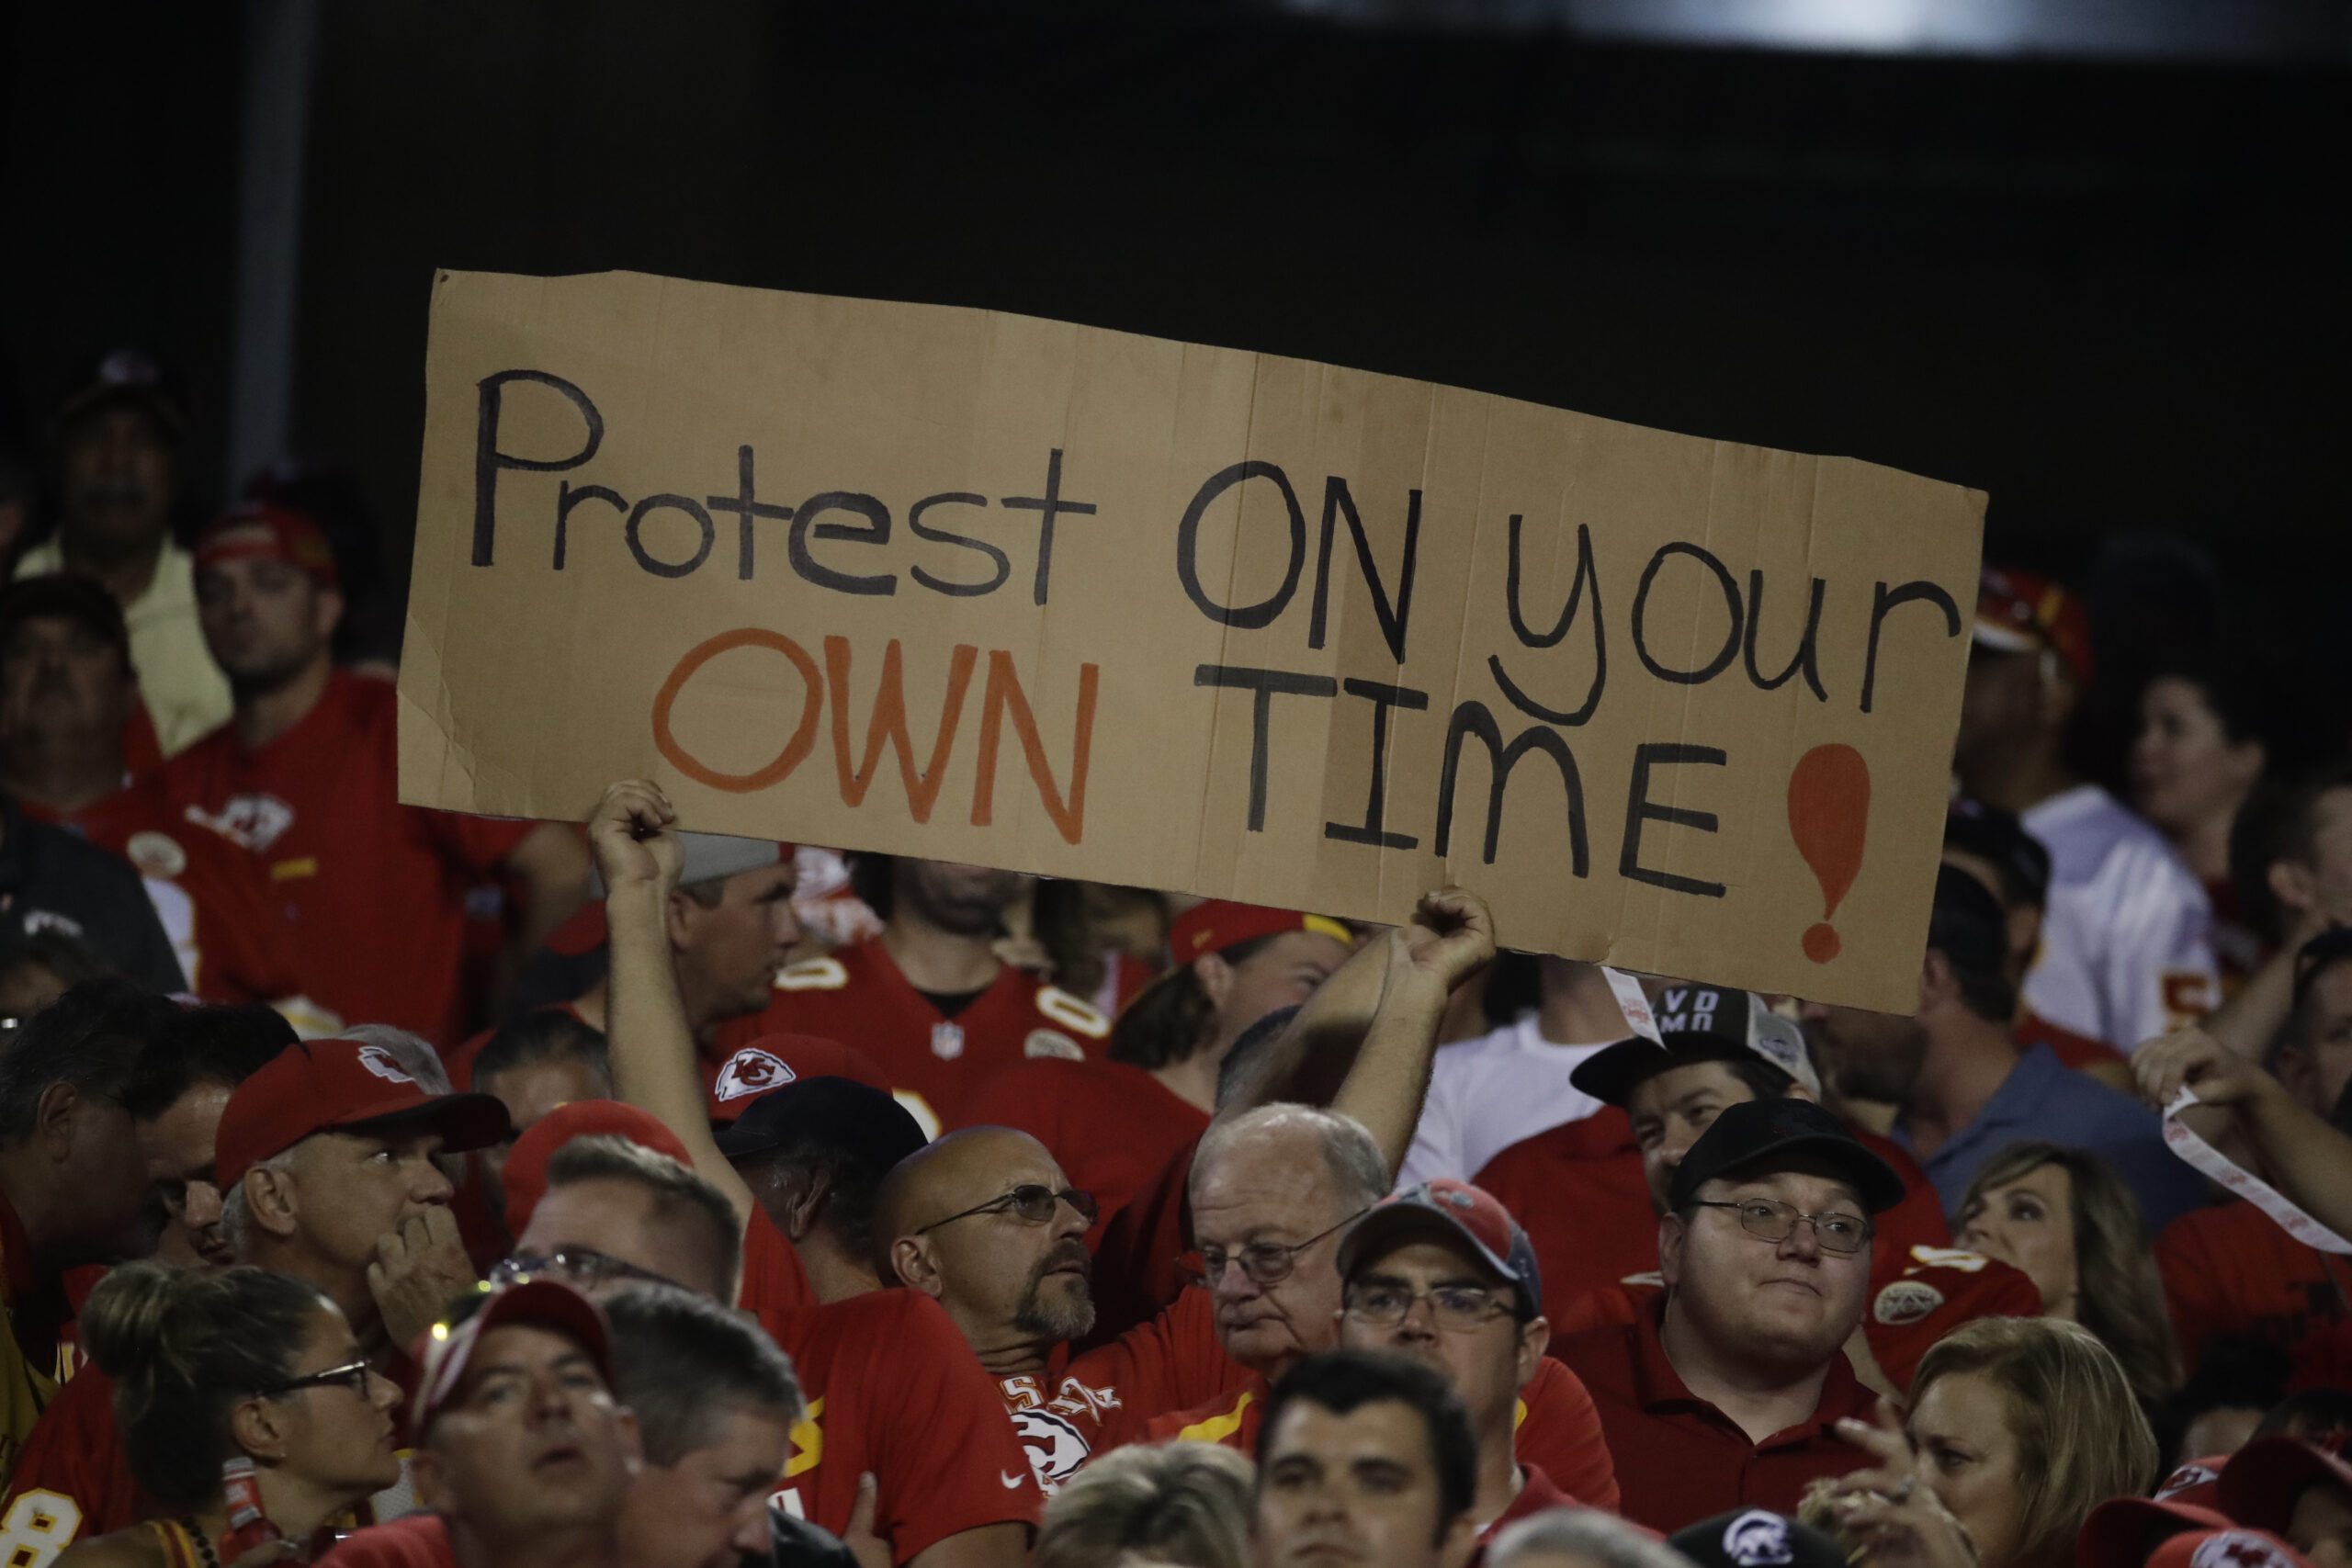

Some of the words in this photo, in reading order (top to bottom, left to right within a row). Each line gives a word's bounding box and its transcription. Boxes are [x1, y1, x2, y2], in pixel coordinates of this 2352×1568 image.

[471, 369, 1097, 606] Protest
[1176, 460, 1422, 665] ON
[1487, 513, 1962, 728] your
[651, 627, 1100, 845] OWN
[1652, 988, 1720, 1013] VD
